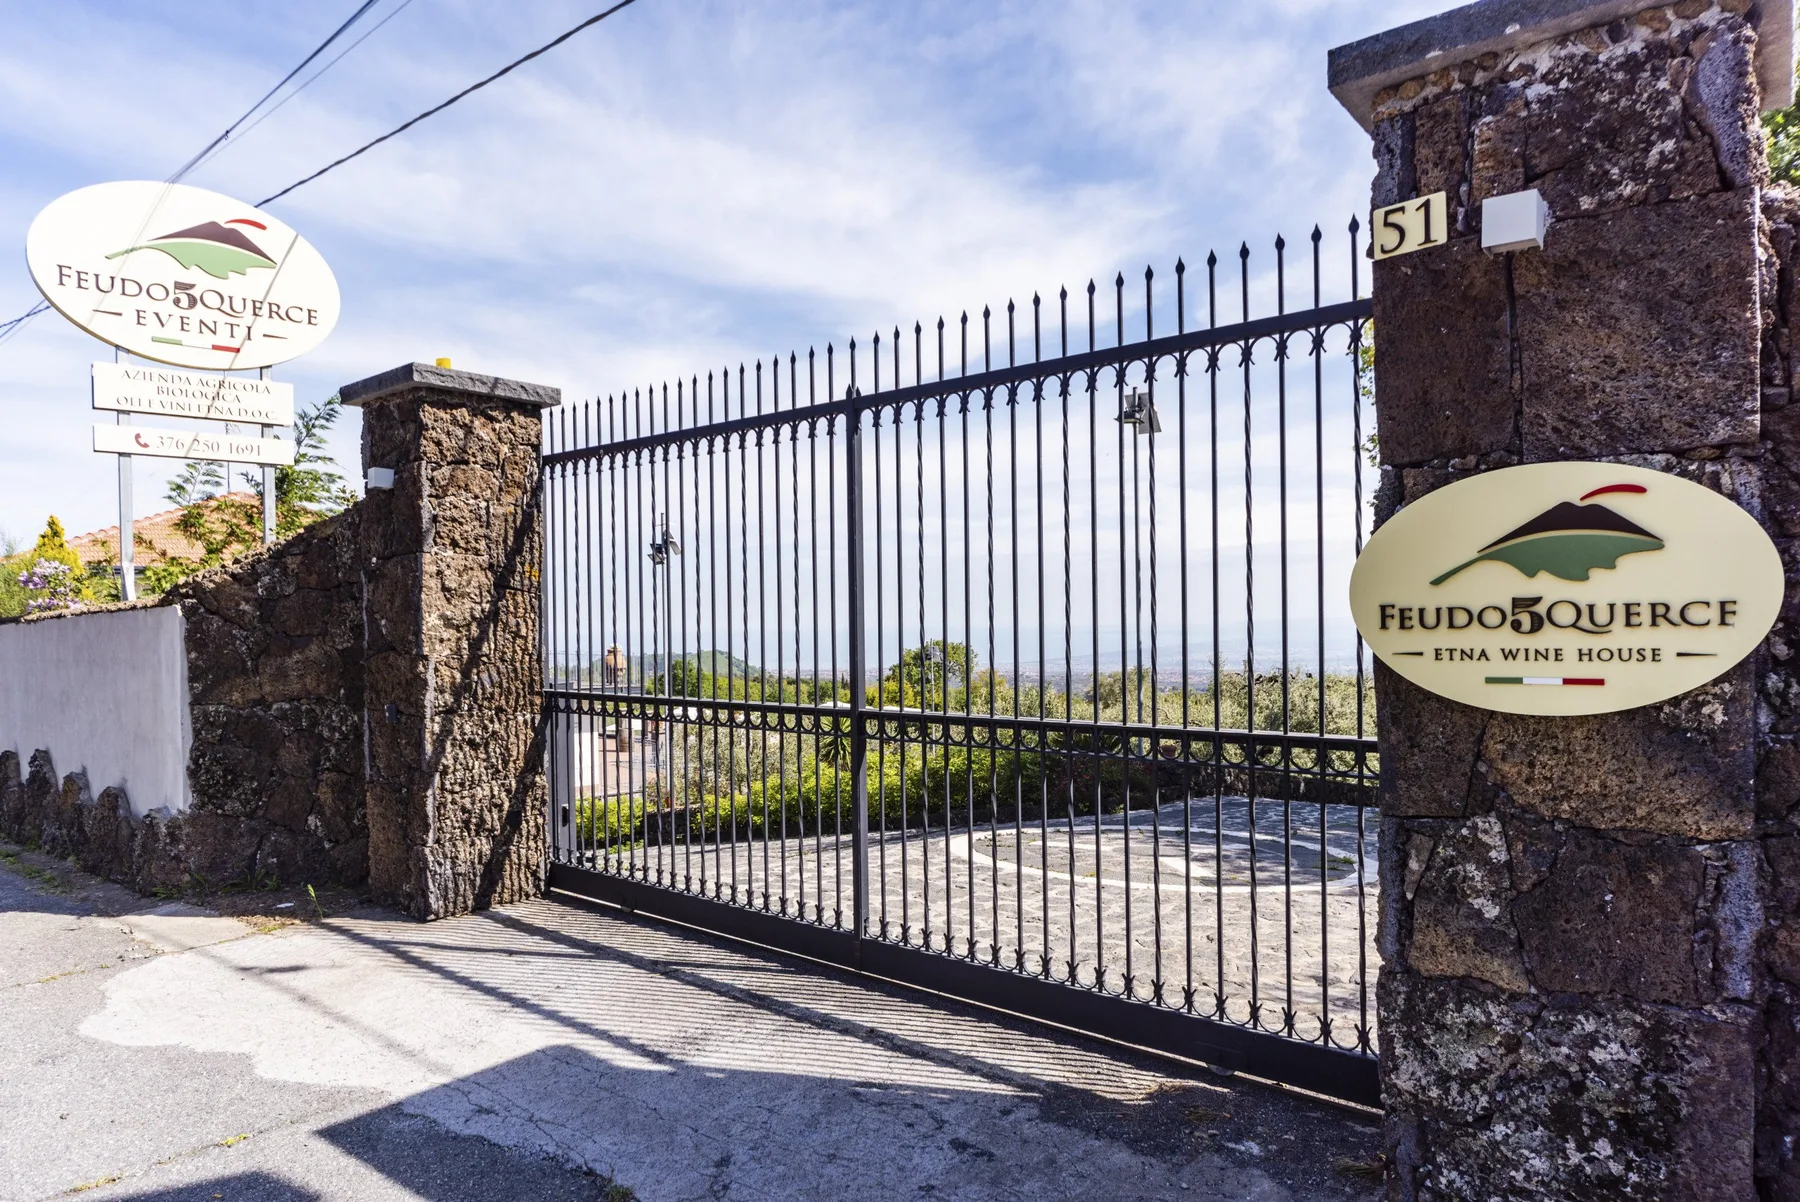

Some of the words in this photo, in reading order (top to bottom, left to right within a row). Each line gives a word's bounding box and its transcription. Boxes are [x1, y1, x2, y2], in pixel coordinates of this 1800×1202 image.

[1380, 197, 1439, 255] 51
[135, 308, 255, 341] EVENTI
[121, 369, 192, 386] AZIENDA
[196, 377, 271, 395] AGRICOLA
[156, 385, 241, 403] BIOLOGICA
[159, 399, 191, 412] VINI
[197, 403, 233, 416] ETNA
[156, 435, 185, 450] 376
[192, 438, 220, 453] 250
[229, 442, 261, 457] 1691
[1433, 647, 1491, 662] ETNA
[1500, 647, 1565, 662] WINE
[1578, 647, 1662, 662] HOUSE
